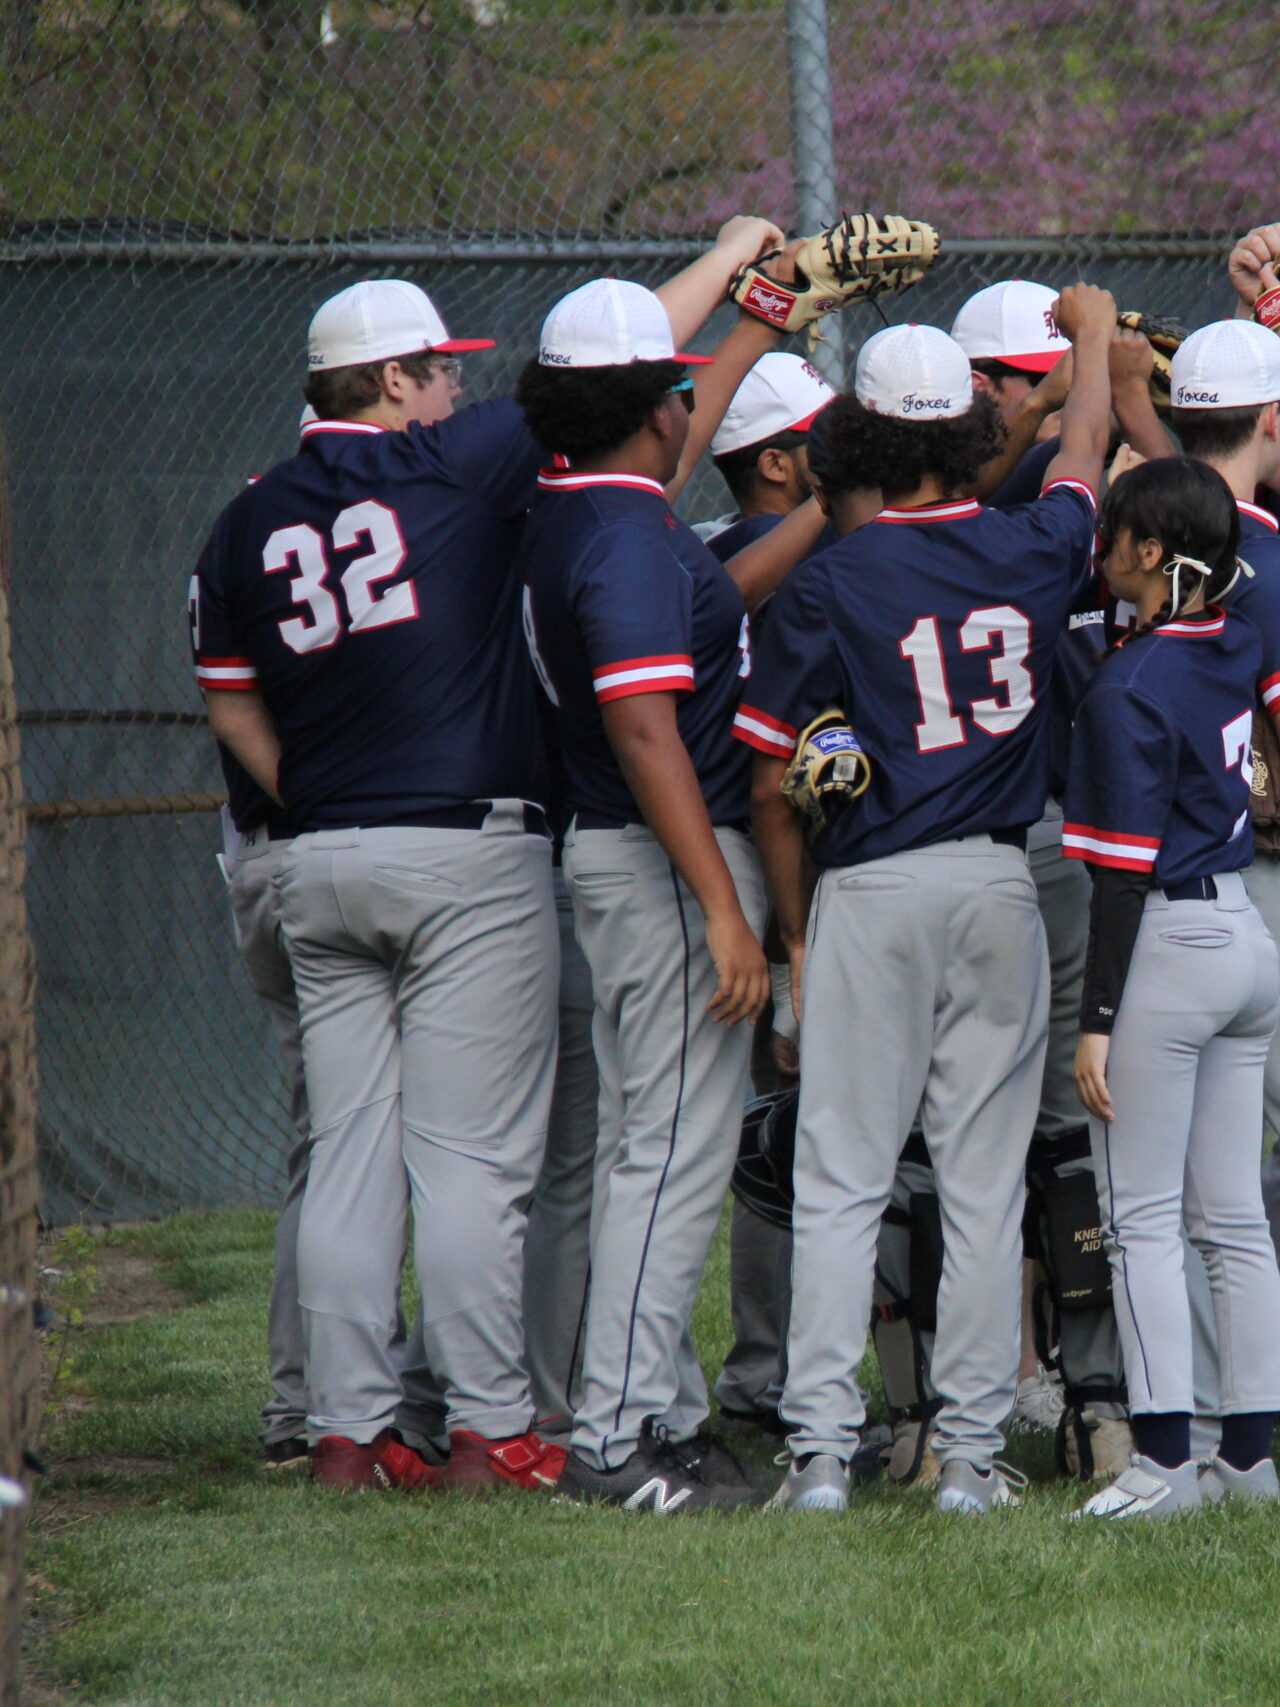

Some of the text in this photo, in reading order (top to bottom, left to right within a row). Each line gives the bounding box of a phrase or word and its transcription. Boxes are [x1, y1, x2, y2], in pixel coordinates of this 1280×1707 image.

[902, 392, 952, 413] Foxes
[1177, 385, 1220, 405] Foxes
[262, 498, 420, 654] 32
[898, 604, 1036, 755] 13
[1081, 1239, 1101, 1254] AID
